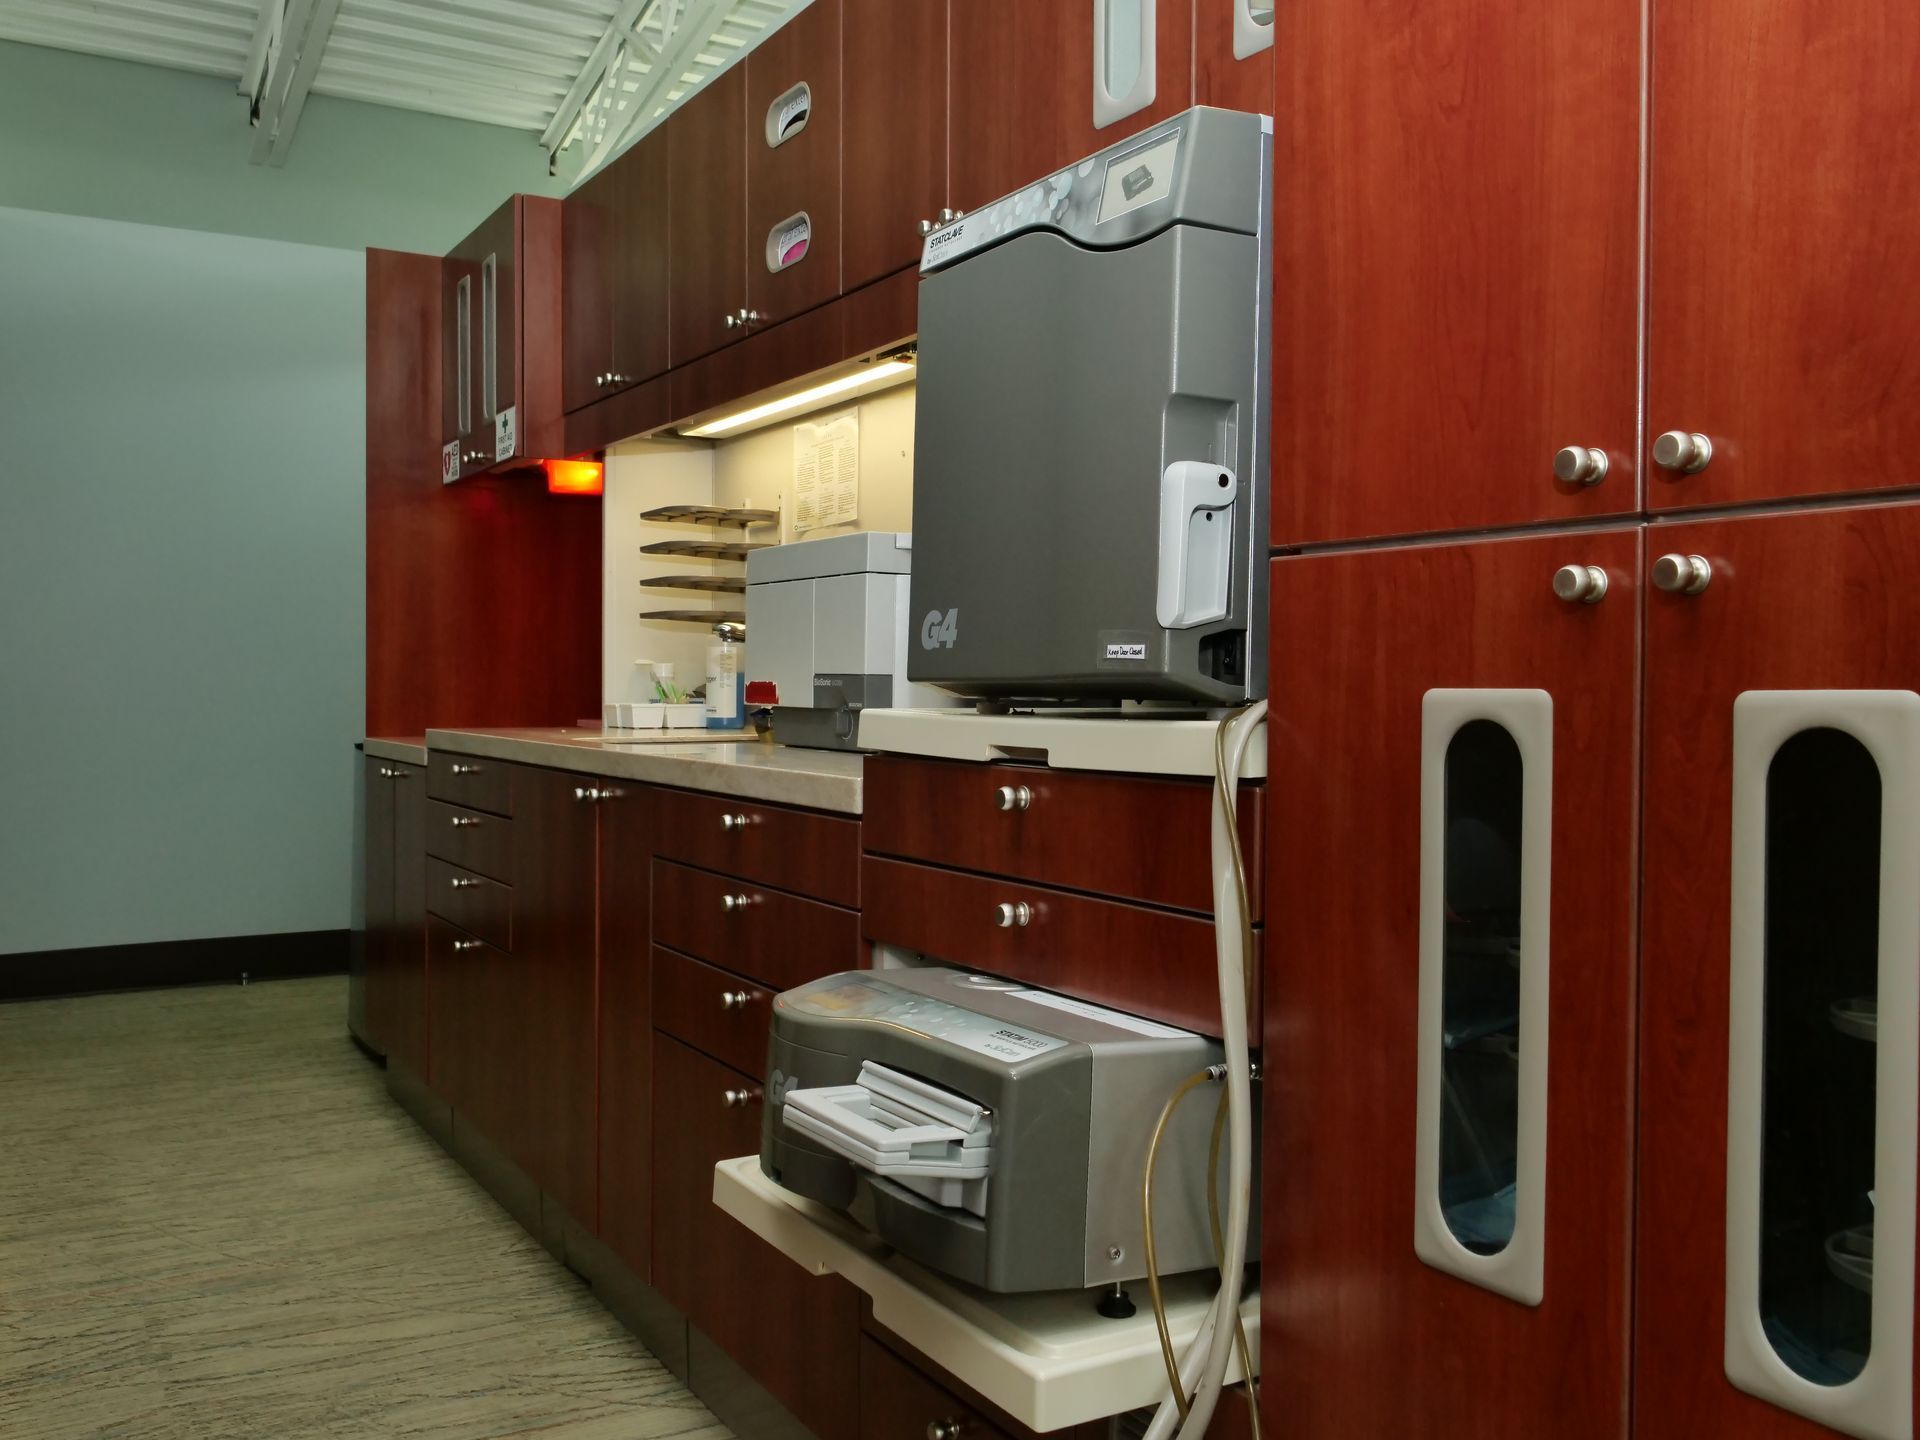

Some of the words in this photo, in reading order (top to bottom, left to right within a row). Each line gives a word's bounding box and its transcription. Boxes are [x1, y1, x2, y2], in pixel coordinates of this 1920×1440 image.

[930, 225, 964, 249] STATCLAVE
[921, 607, 959, 650] G4
[996, 1029, 1029, 1041] STATIM
